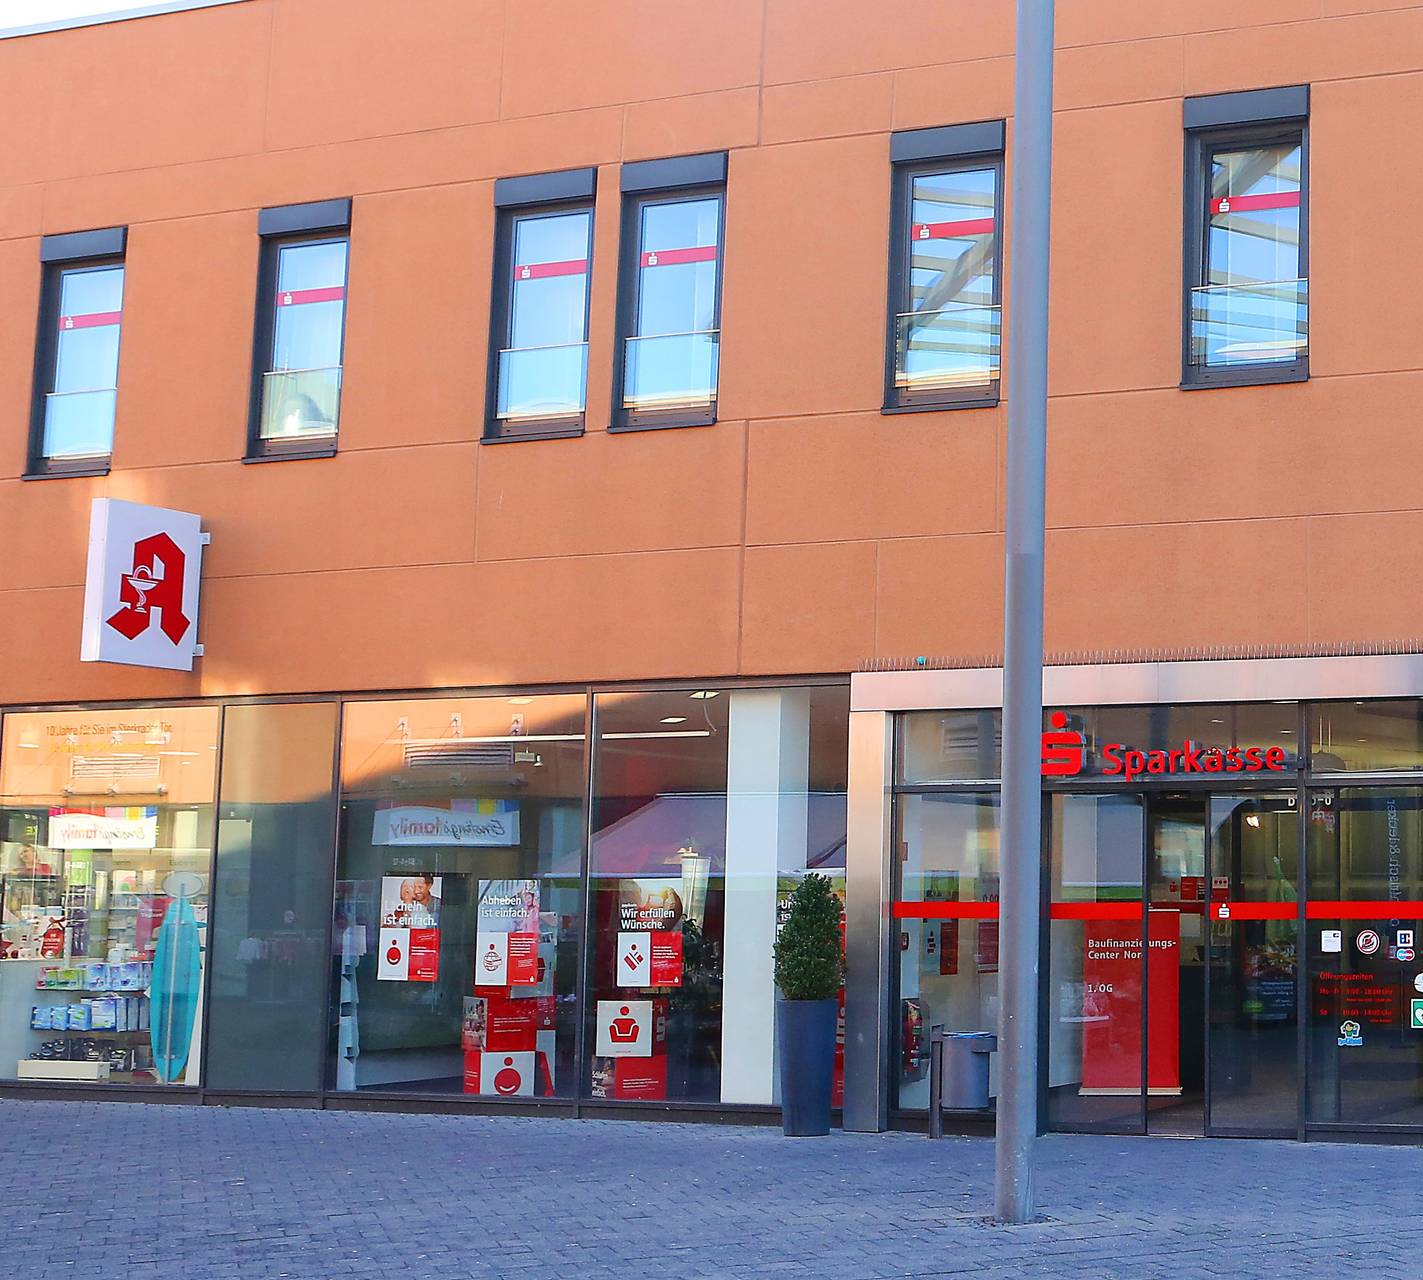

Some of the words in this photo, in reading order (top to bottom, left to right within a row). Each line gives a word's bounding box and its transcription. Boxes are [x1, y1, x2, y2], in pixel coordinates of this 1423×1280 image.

[1103, 740, 1287, 782] Sparkasse
[481, 895, 522, 905] Abheben
[481, 907, 493, 917] ist
[495, 907, 530, 918] einfach.
[621, 908, 638, 918] Wir
[639, 907, 675, 918] erfüllen
[383, 913, 397, 925] ist
[398, 913, 438, 926] einfach.
[621, 919, 665, 930] Wünsche.
[1088, 938, 1177, 950] Baufinanzieungs-
[1088, 950, 1120, 960] Center
[1124, 950, 1143, 960] Nor
